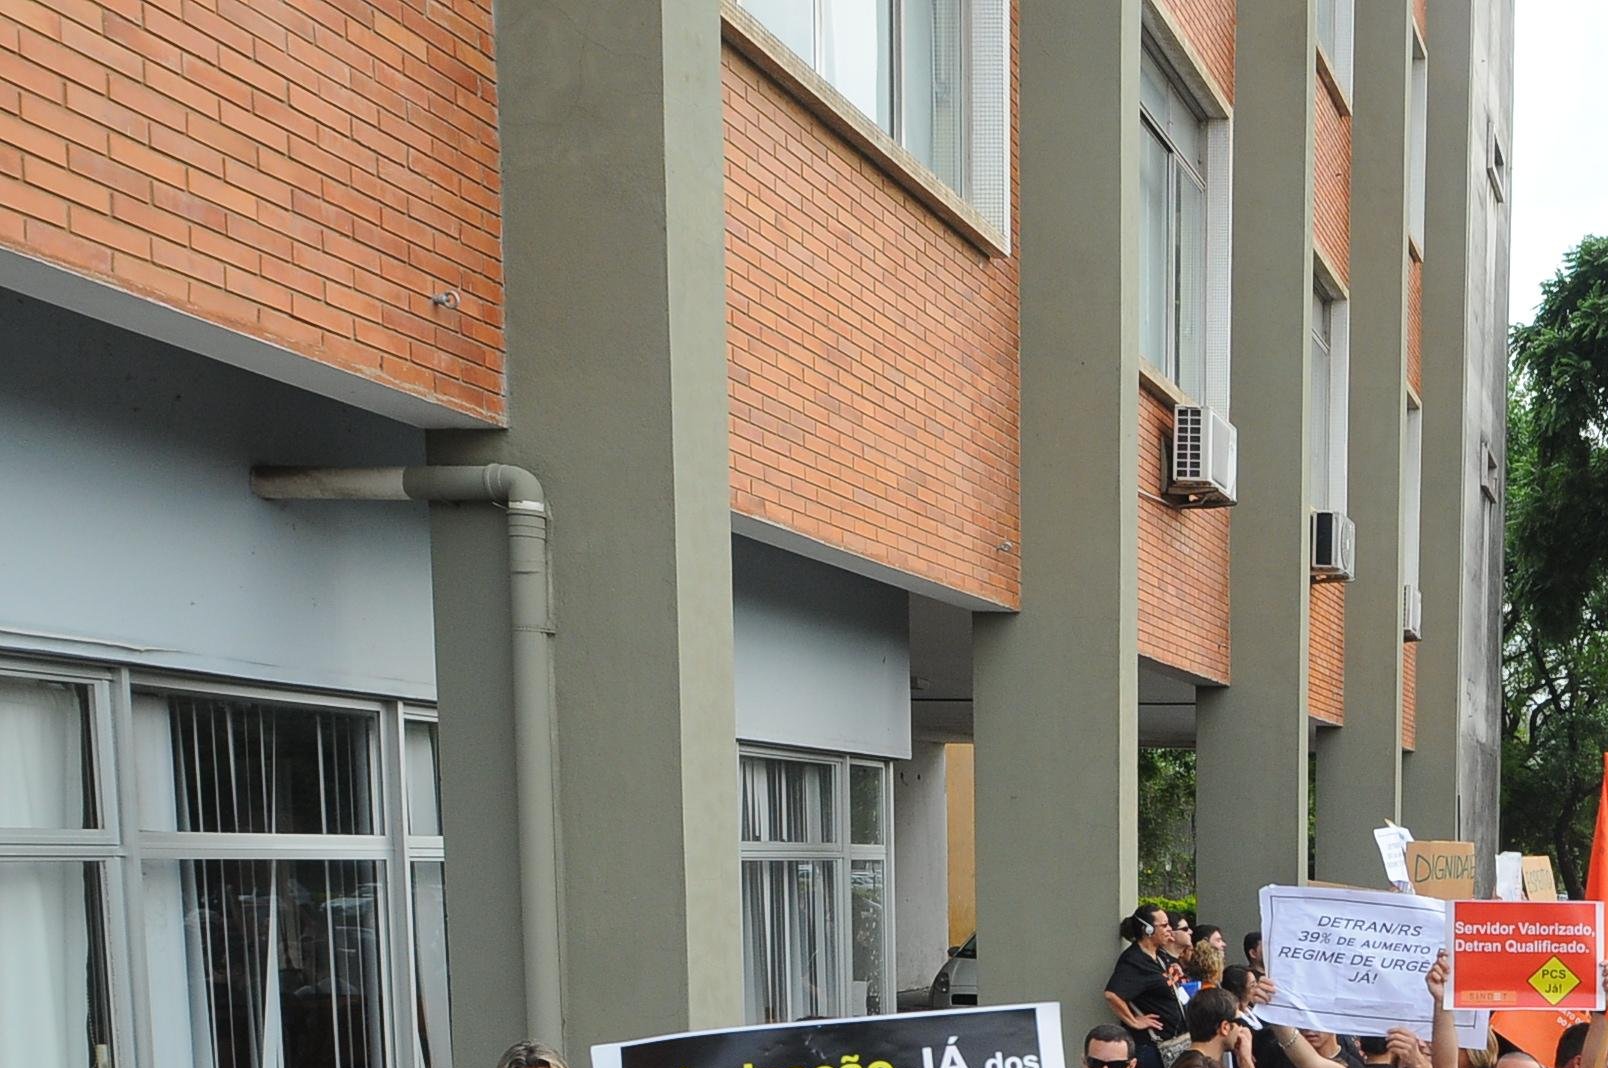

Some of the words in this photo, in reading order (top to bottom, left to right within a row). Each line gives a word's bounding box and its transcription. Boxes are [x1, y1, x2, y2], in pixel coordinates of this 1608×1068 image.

[1317, 915, 1423, 938] DETRAN/RS
[1455, 922, 1515, 935] Servidor
[1518, 922, 1595, 937] Valorizado,
[1298, 931, 1333, 944] 39%
[1336, 936, 1356, 947] DE
[1360, 940, 1431, 955] AUMENTO
[1455, 939, 1501, 952] Detran
[1505, 939, 1590, 954] Qualificado.
[1278, 946, 1346, 964] REGIME
[1350, 954, 1376, 967] DE
[1348, 970, 1378, 985] JÁ!
[1541, 969, 1566, 979] PCS
